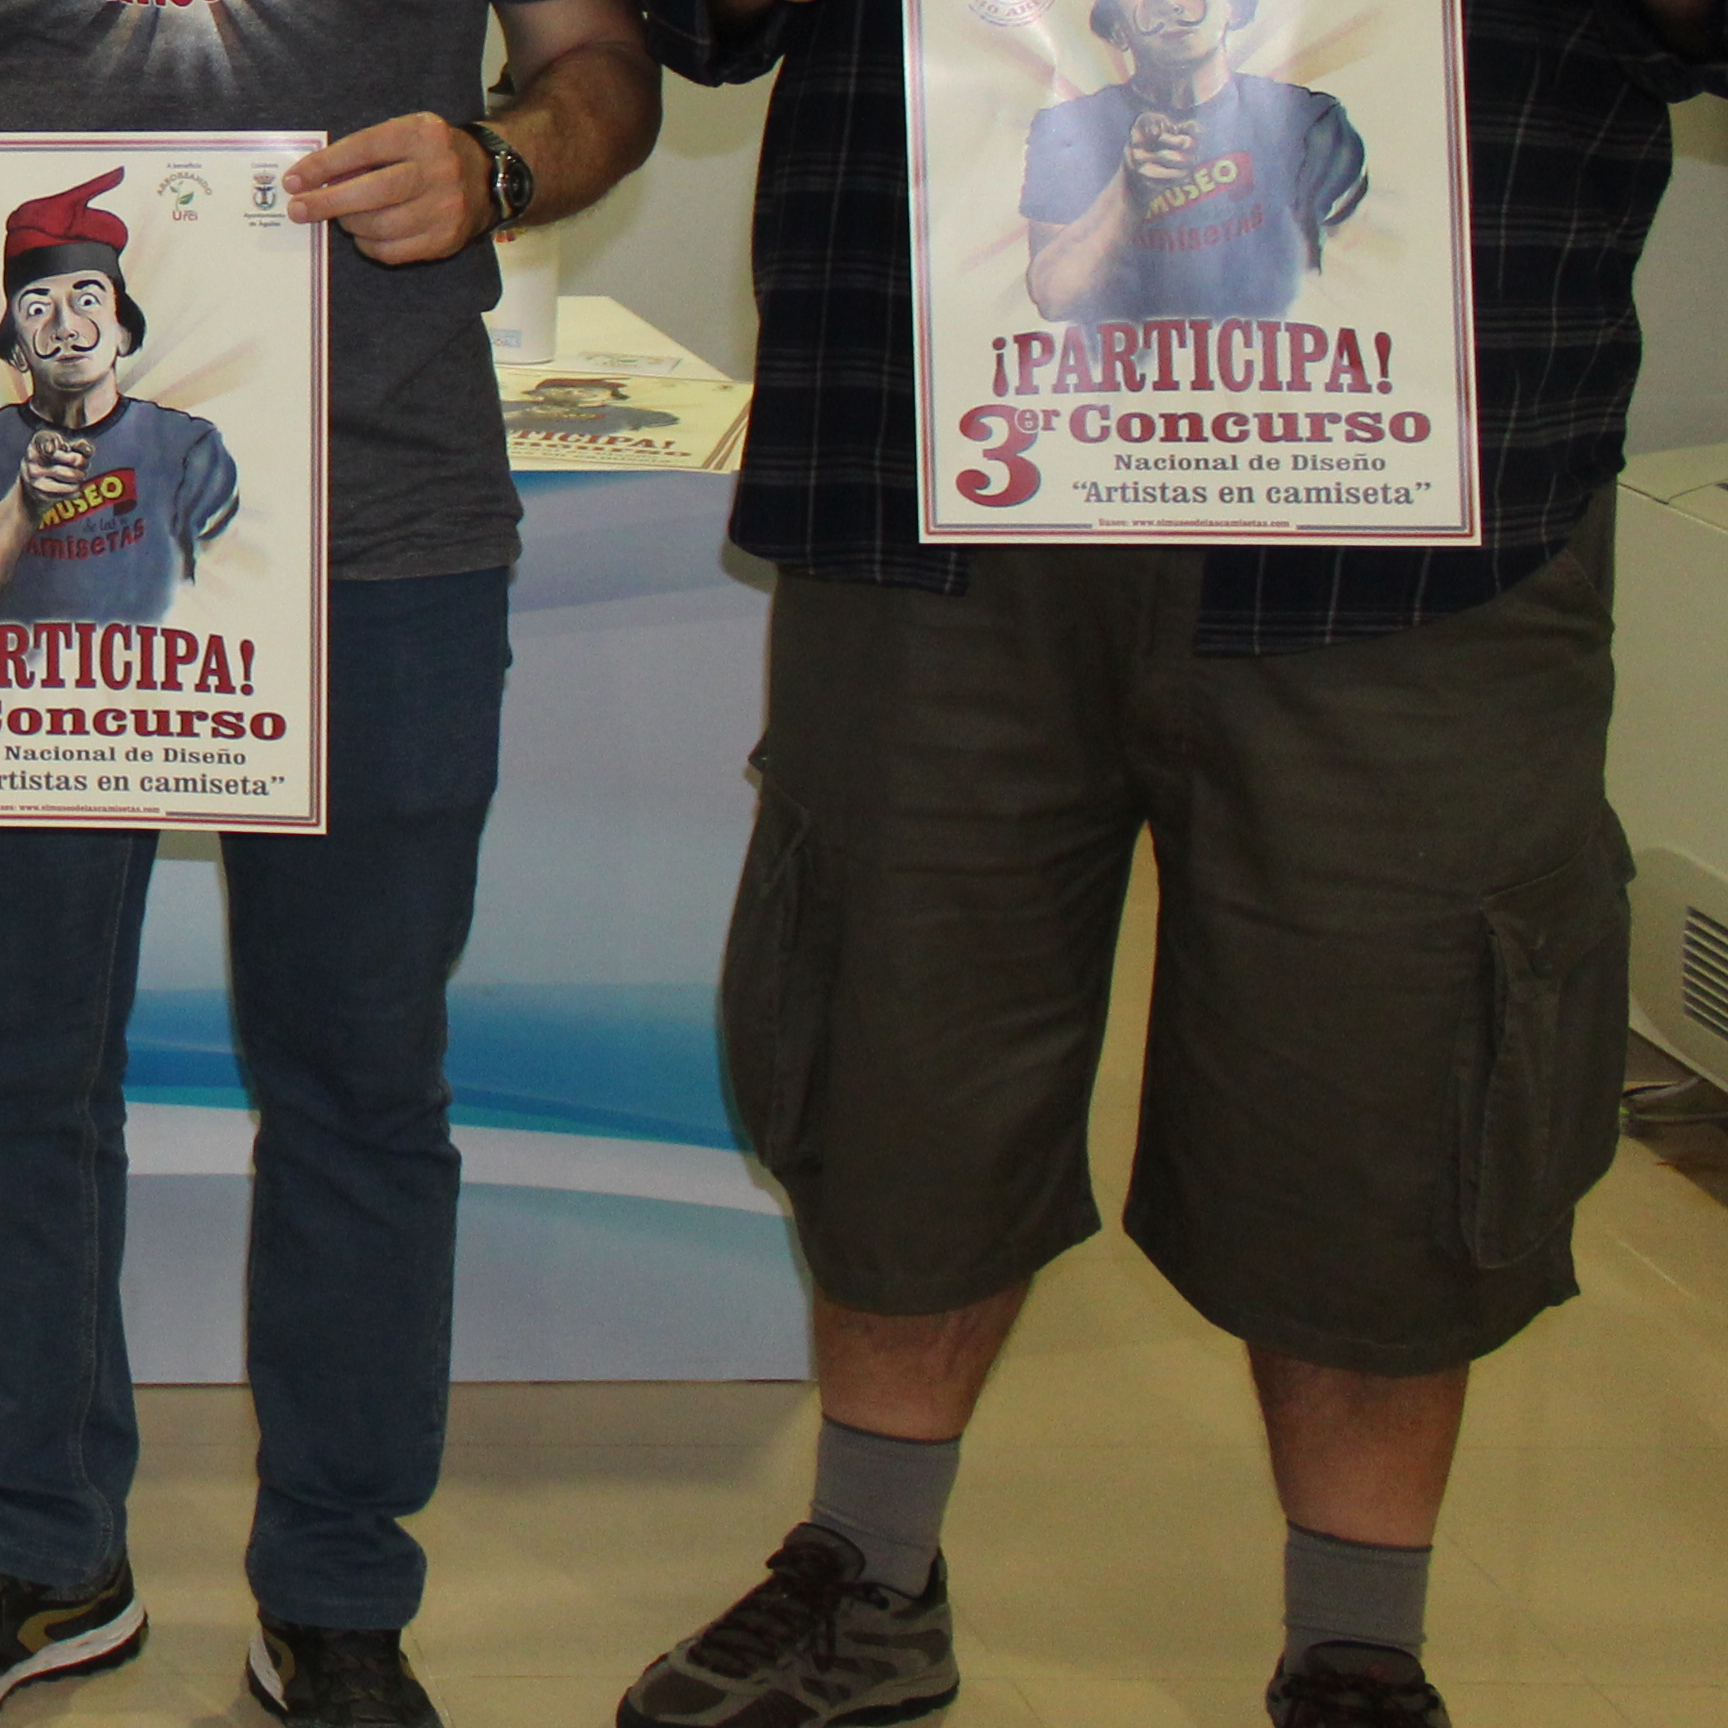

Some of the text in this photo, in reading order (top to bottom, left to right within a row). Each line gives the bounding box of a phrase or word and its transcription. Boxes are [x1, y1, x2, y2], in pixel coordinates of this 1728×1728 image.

[1146, 159, 1238, 219] MUSEO
[991, 317, 1393, 397] ¡PARTICIPA!
[1068, 403, 1432, 444] Concurso
[1114, 452, 1386, 471] Nacional de Diseño
[39, 475, 124, 530] MUSEO
[1073, 480, 1432, 505] “Artistas en camiseta”
[5, 745, 246, 765] Nacional de Diseño
[98, 775, 130, 792] en
[140, 773, 285, 796] camiseta”
